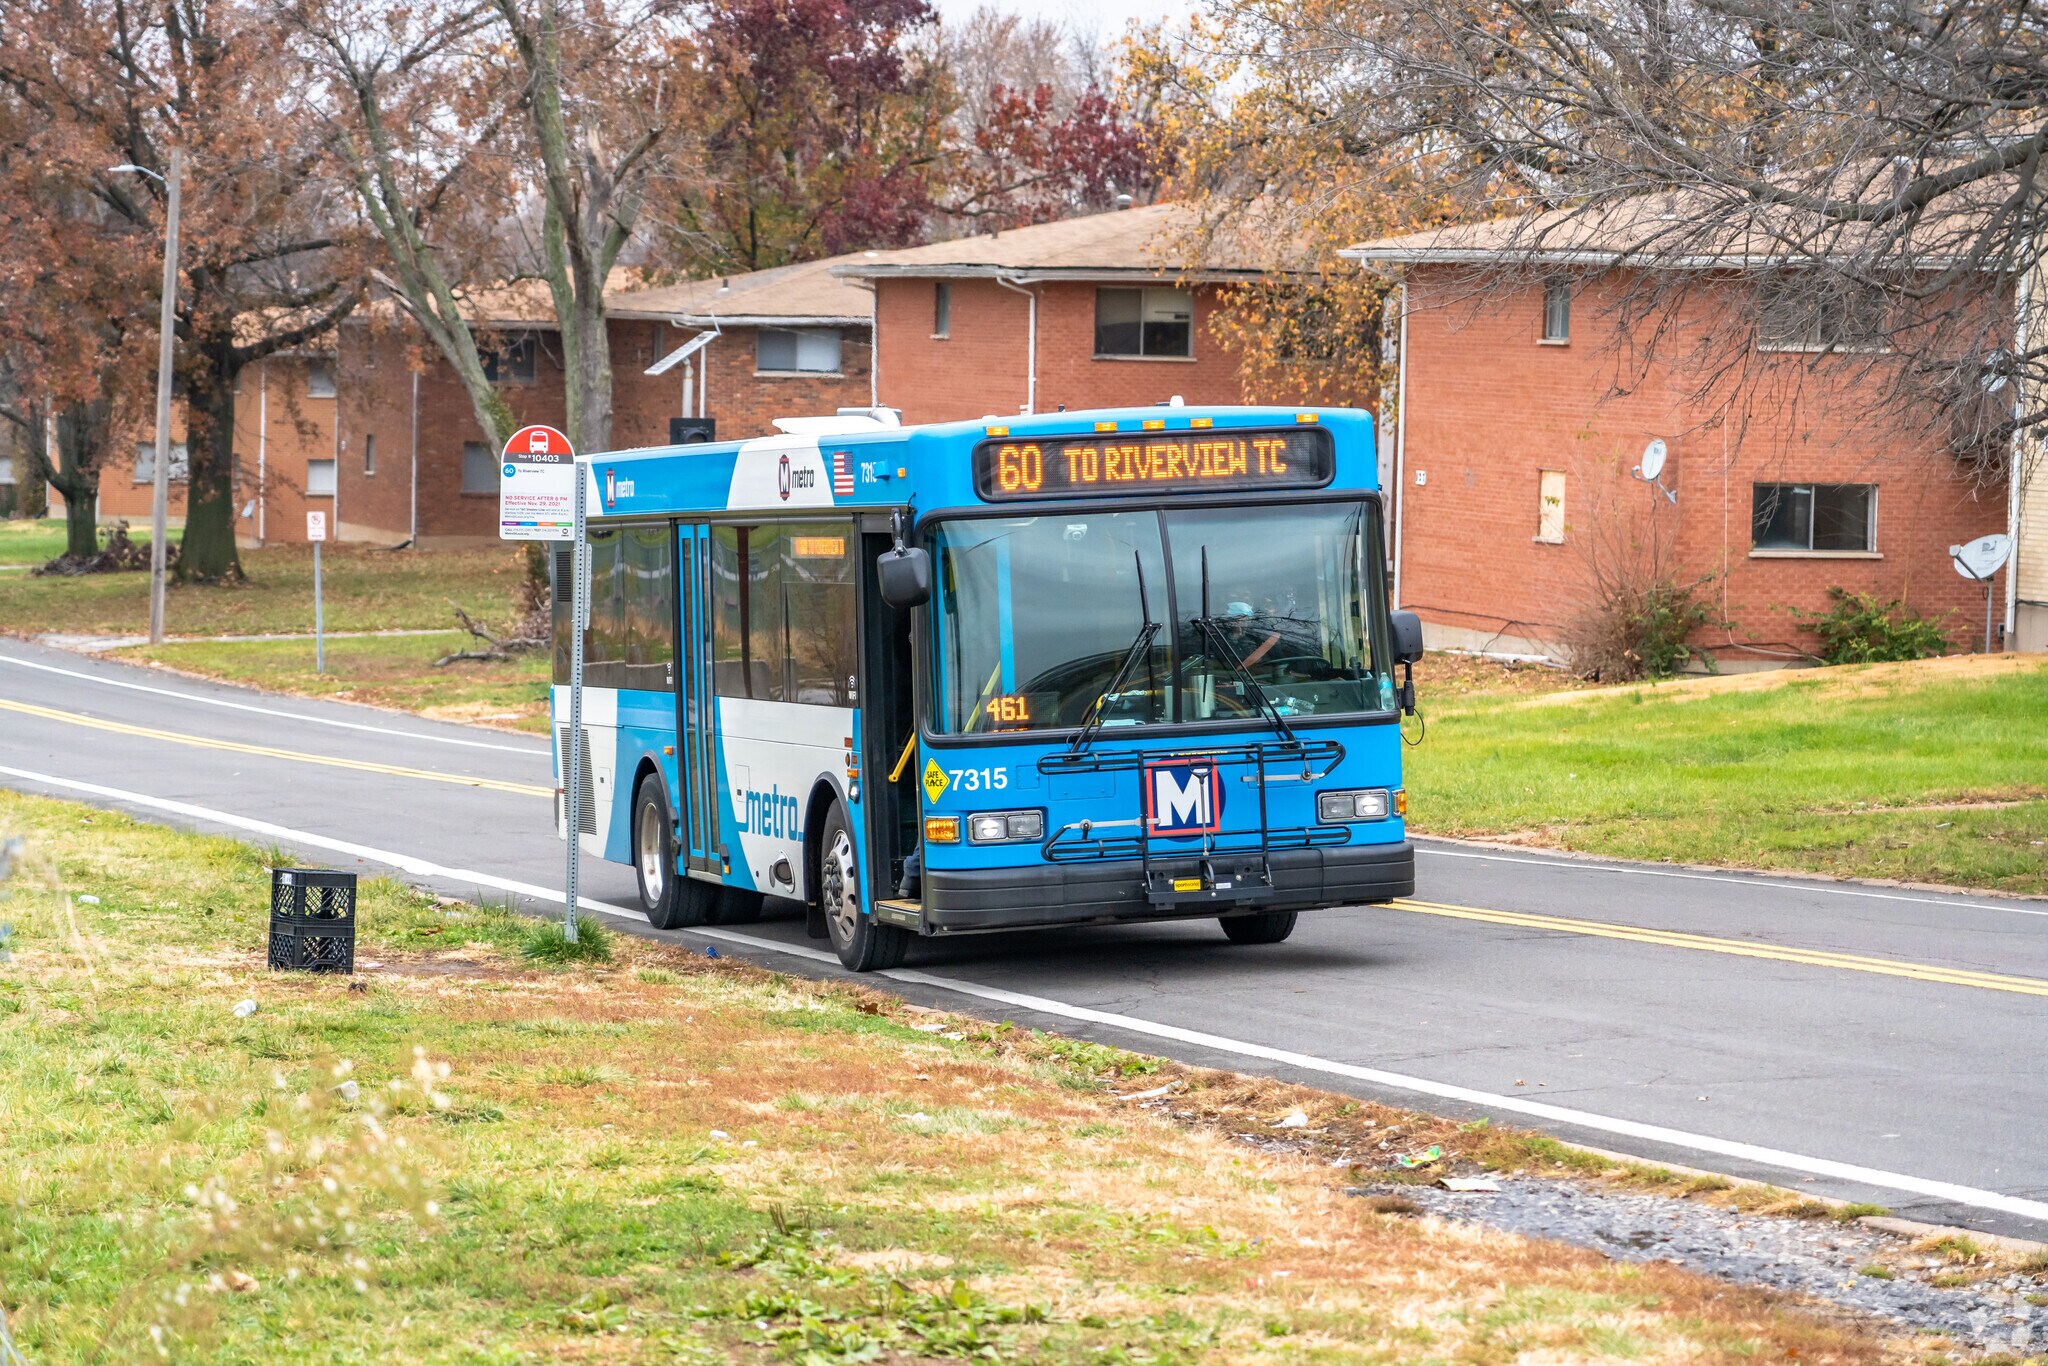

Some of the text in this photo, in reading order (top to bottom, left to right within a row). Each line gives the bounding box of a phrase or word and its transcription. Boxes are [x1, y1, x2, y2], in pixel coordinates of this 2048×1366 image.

[532, 454, 559, 463] 10403
[999, 440, 1287, 490] 60 TO RIVERVIEW TC
[616, 477, 635, 499] metro
[791, 465, 815, 490] metro
[986, 696, 1029, 722] 461
[925, 779, 943, 787] PLACE
[926, 770, 939, 779] SAFE
[948, 767, 1008, 792] 7315
[1156, 768, 1211, 827] M
[741, 784, 800, 841] metro
